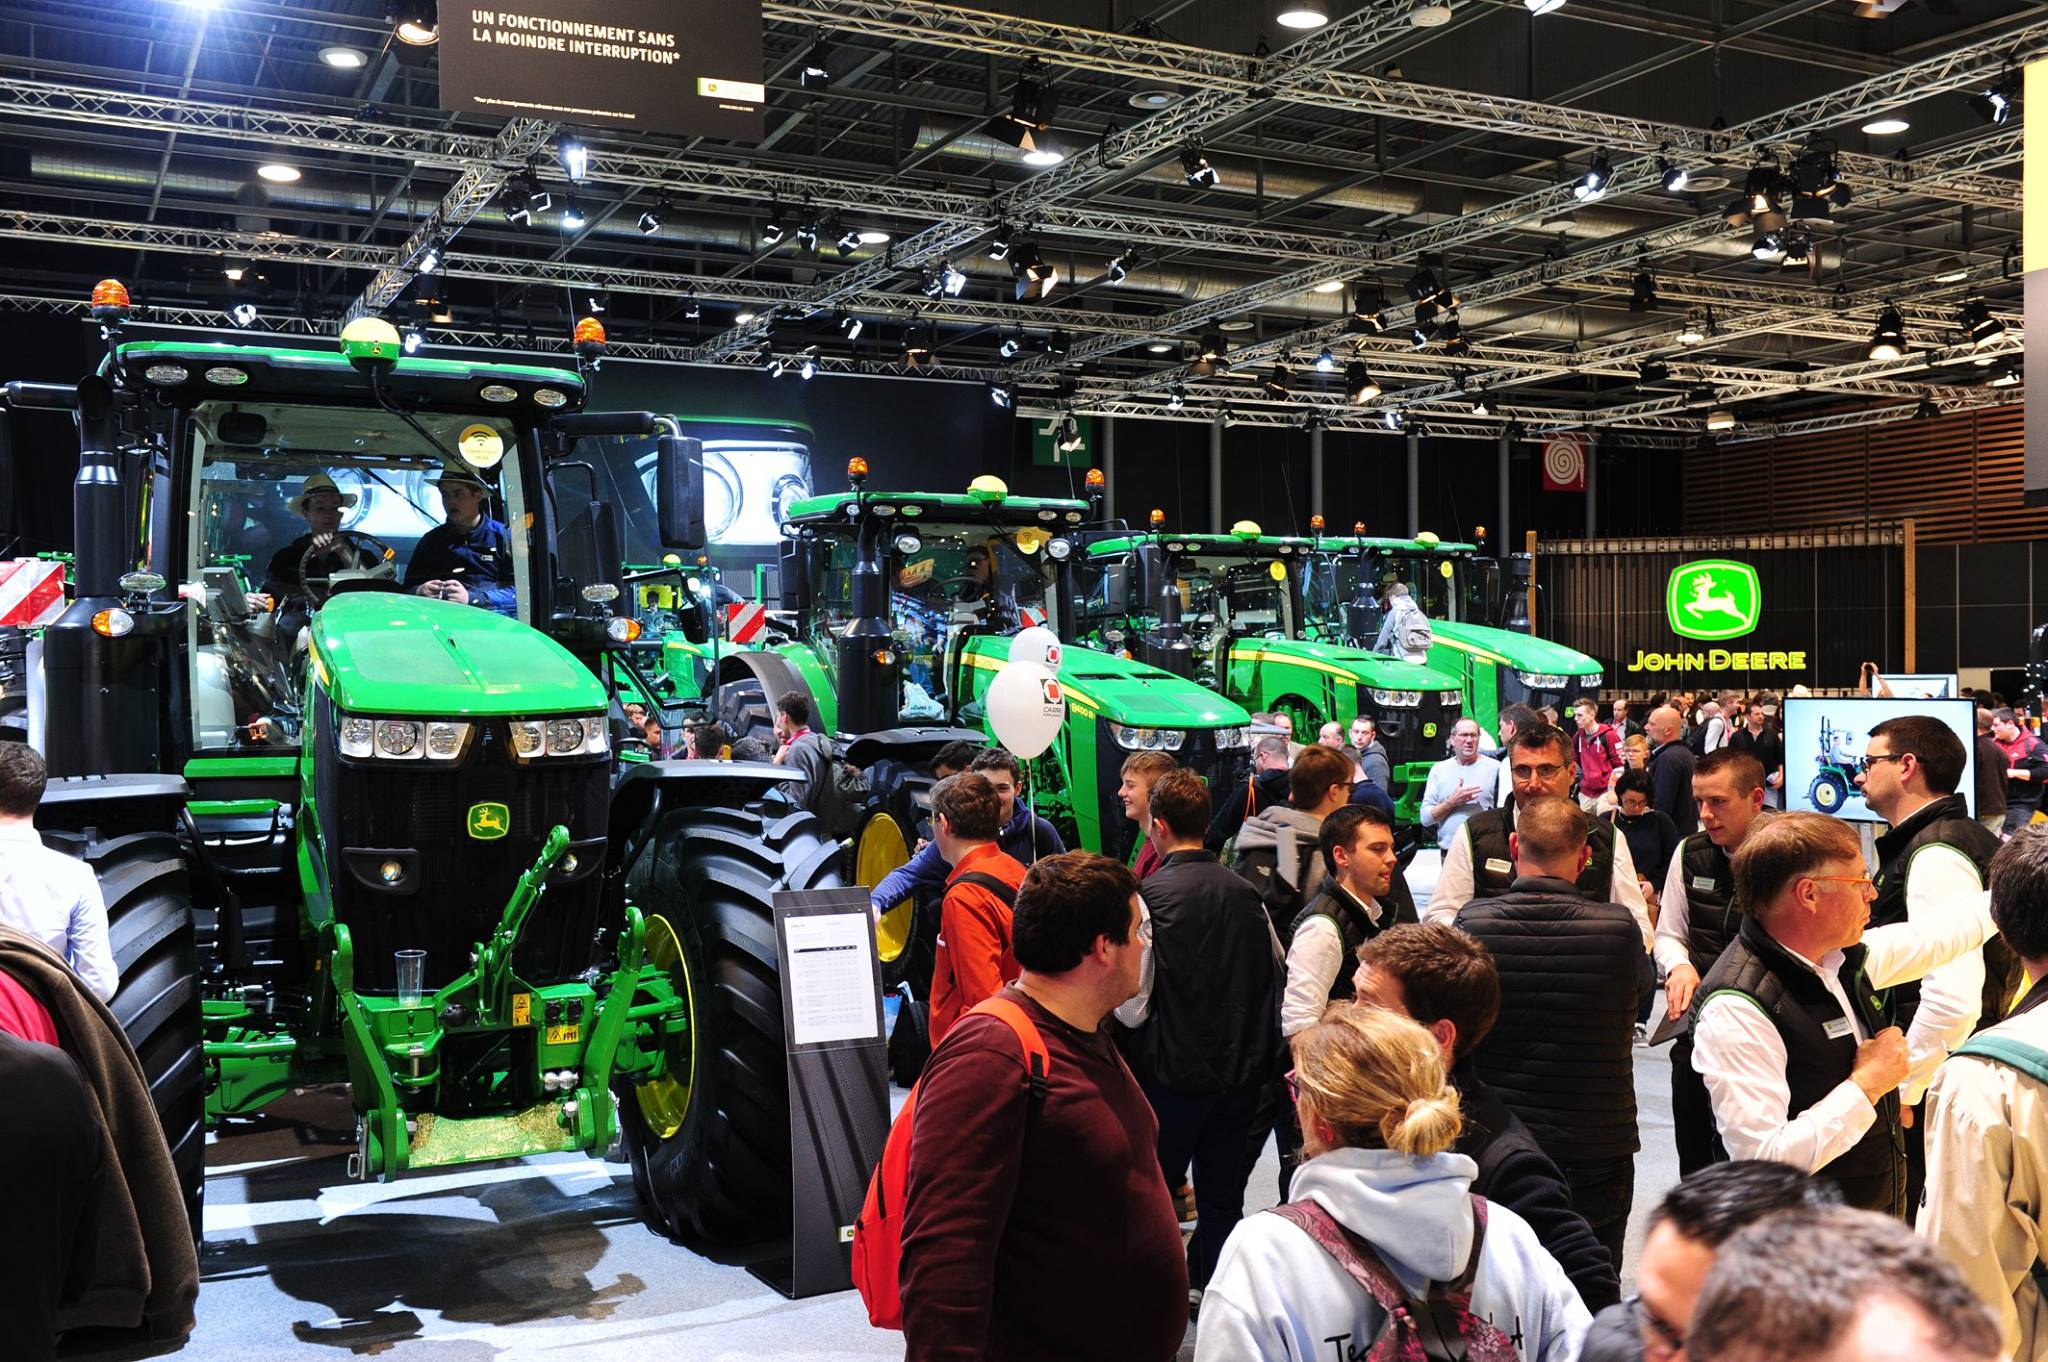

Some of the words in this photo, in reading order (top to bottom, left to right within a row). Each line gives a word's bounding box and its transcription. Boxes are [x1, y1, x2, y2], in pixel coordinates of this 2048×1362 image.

[472, 10, 494, 25] UN
[499, 13, 635, 42] FONCTIONNEMENT
[639, 31, 675, 47] SANS
[473, 28, 492, 43] LA
[496, 31, 565, 52] MOINDRE
[1628, 650, 1704, 672] JOHN
[1709, 649, 1807, 670] DEERE
